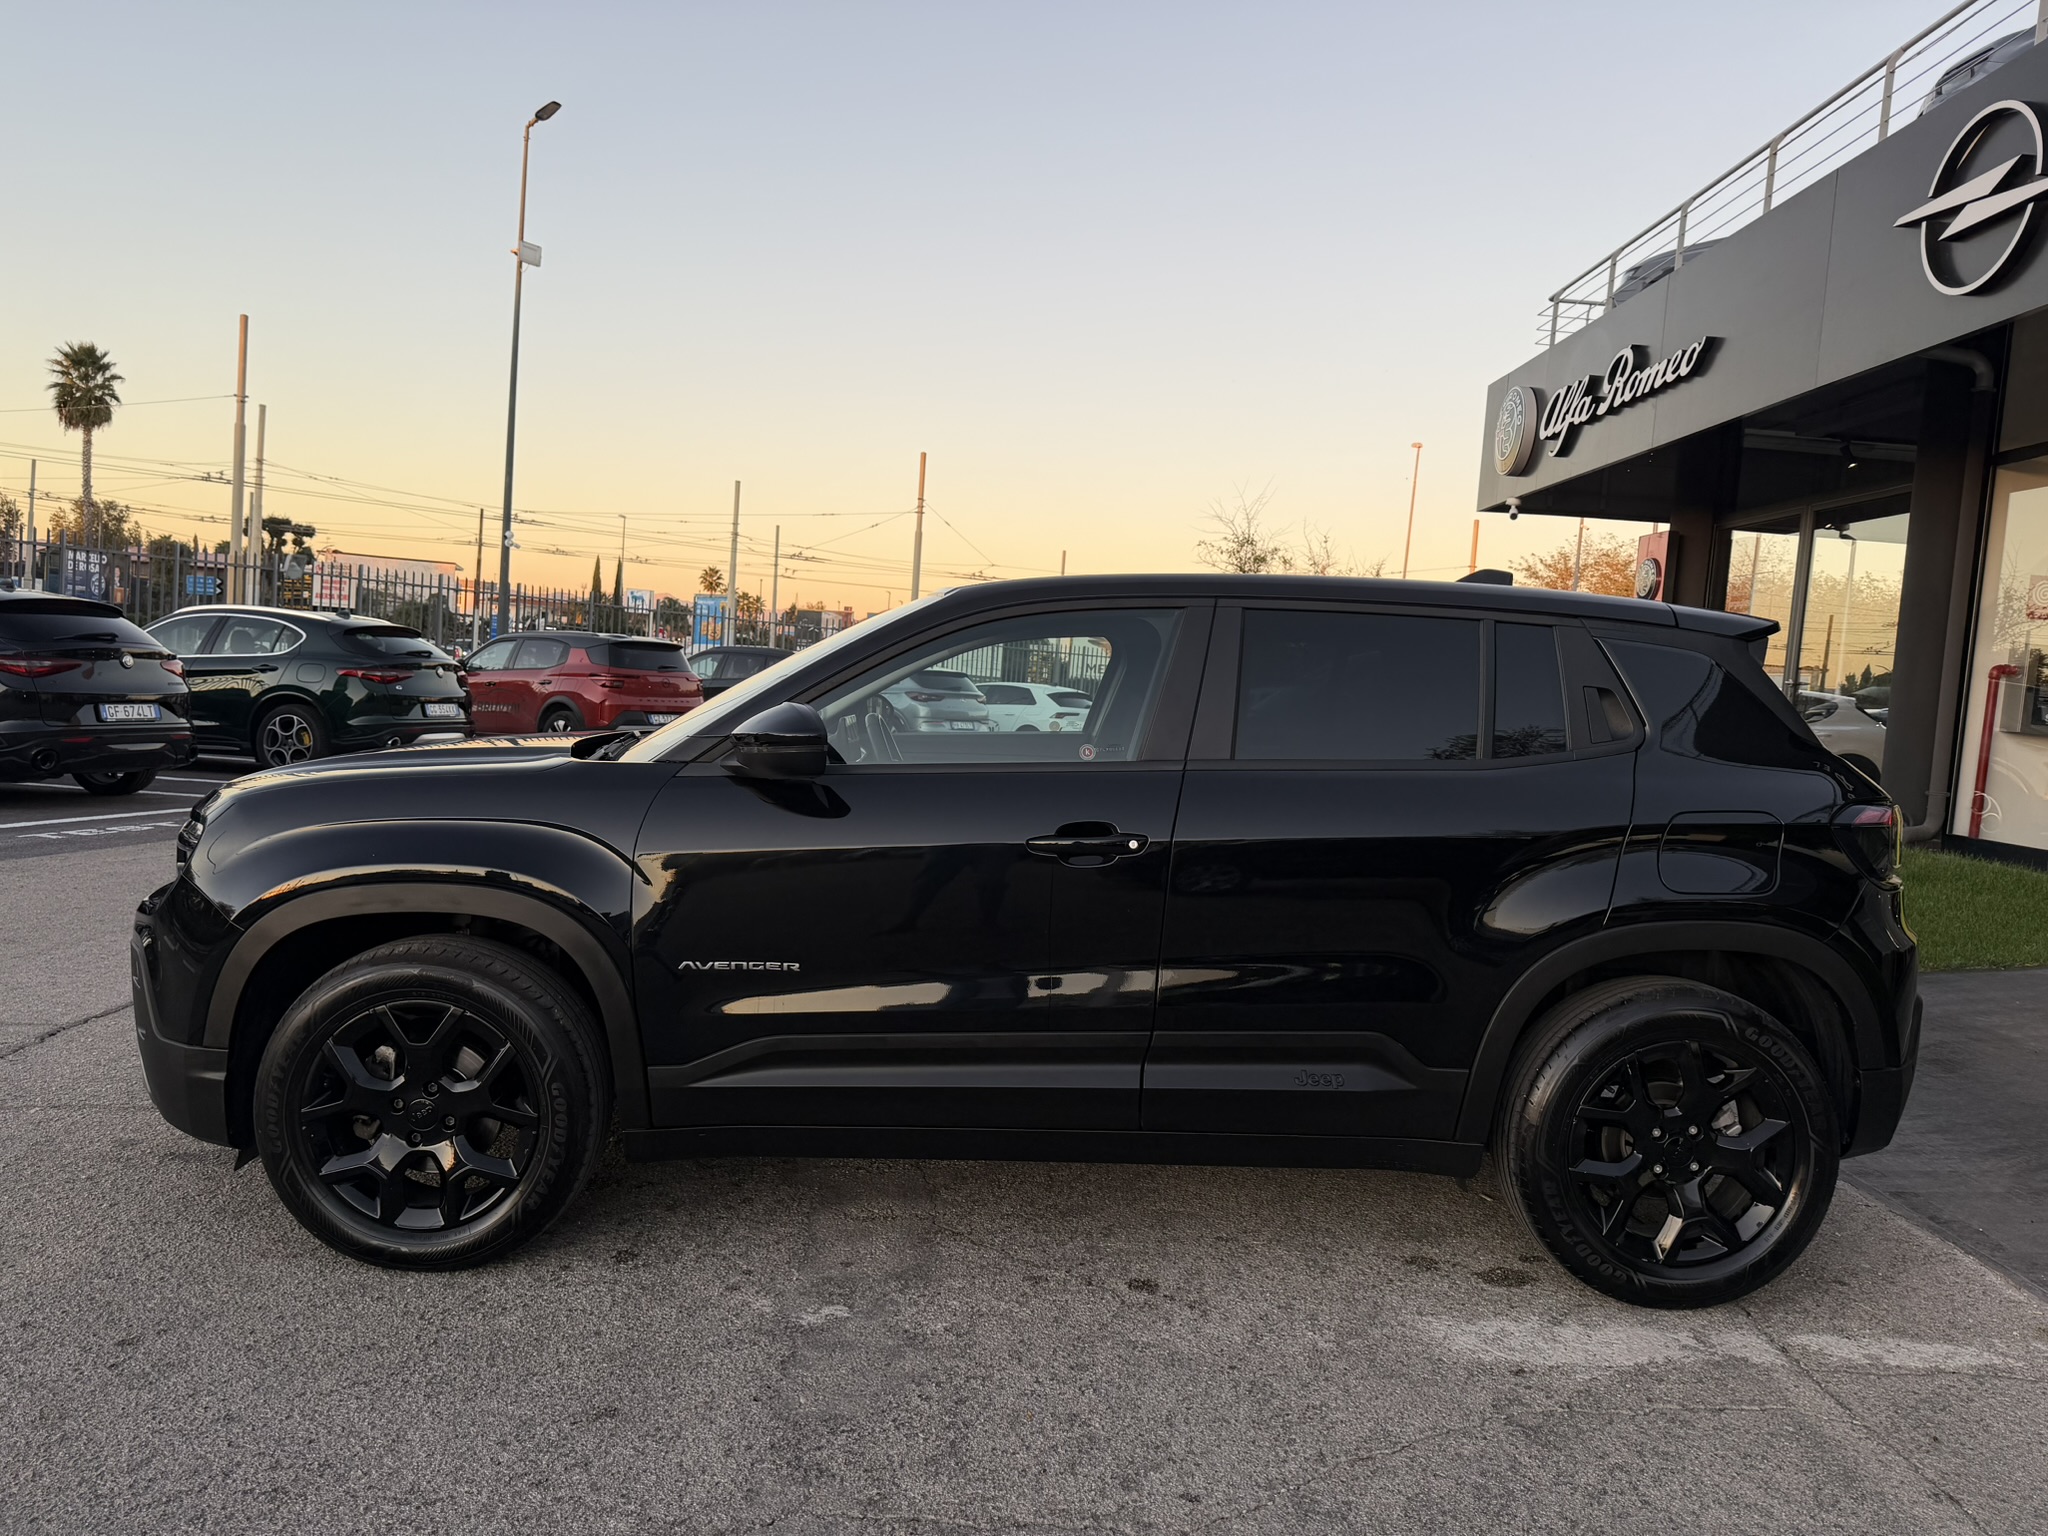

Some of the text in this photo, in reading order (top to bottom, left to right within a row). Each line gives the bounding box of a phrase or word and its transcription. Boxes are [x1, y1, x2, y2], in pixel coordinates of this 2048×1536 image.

[1540, 336, 1710, 457] Alfa Romeo
[107, 705, 154, 718] GF 674LT
[678, 961, 800, 971] AVENGER
[1294, 1069, 1344, 1089] Jeep
[525, 1082, 568, 1210] GOODYEAR
